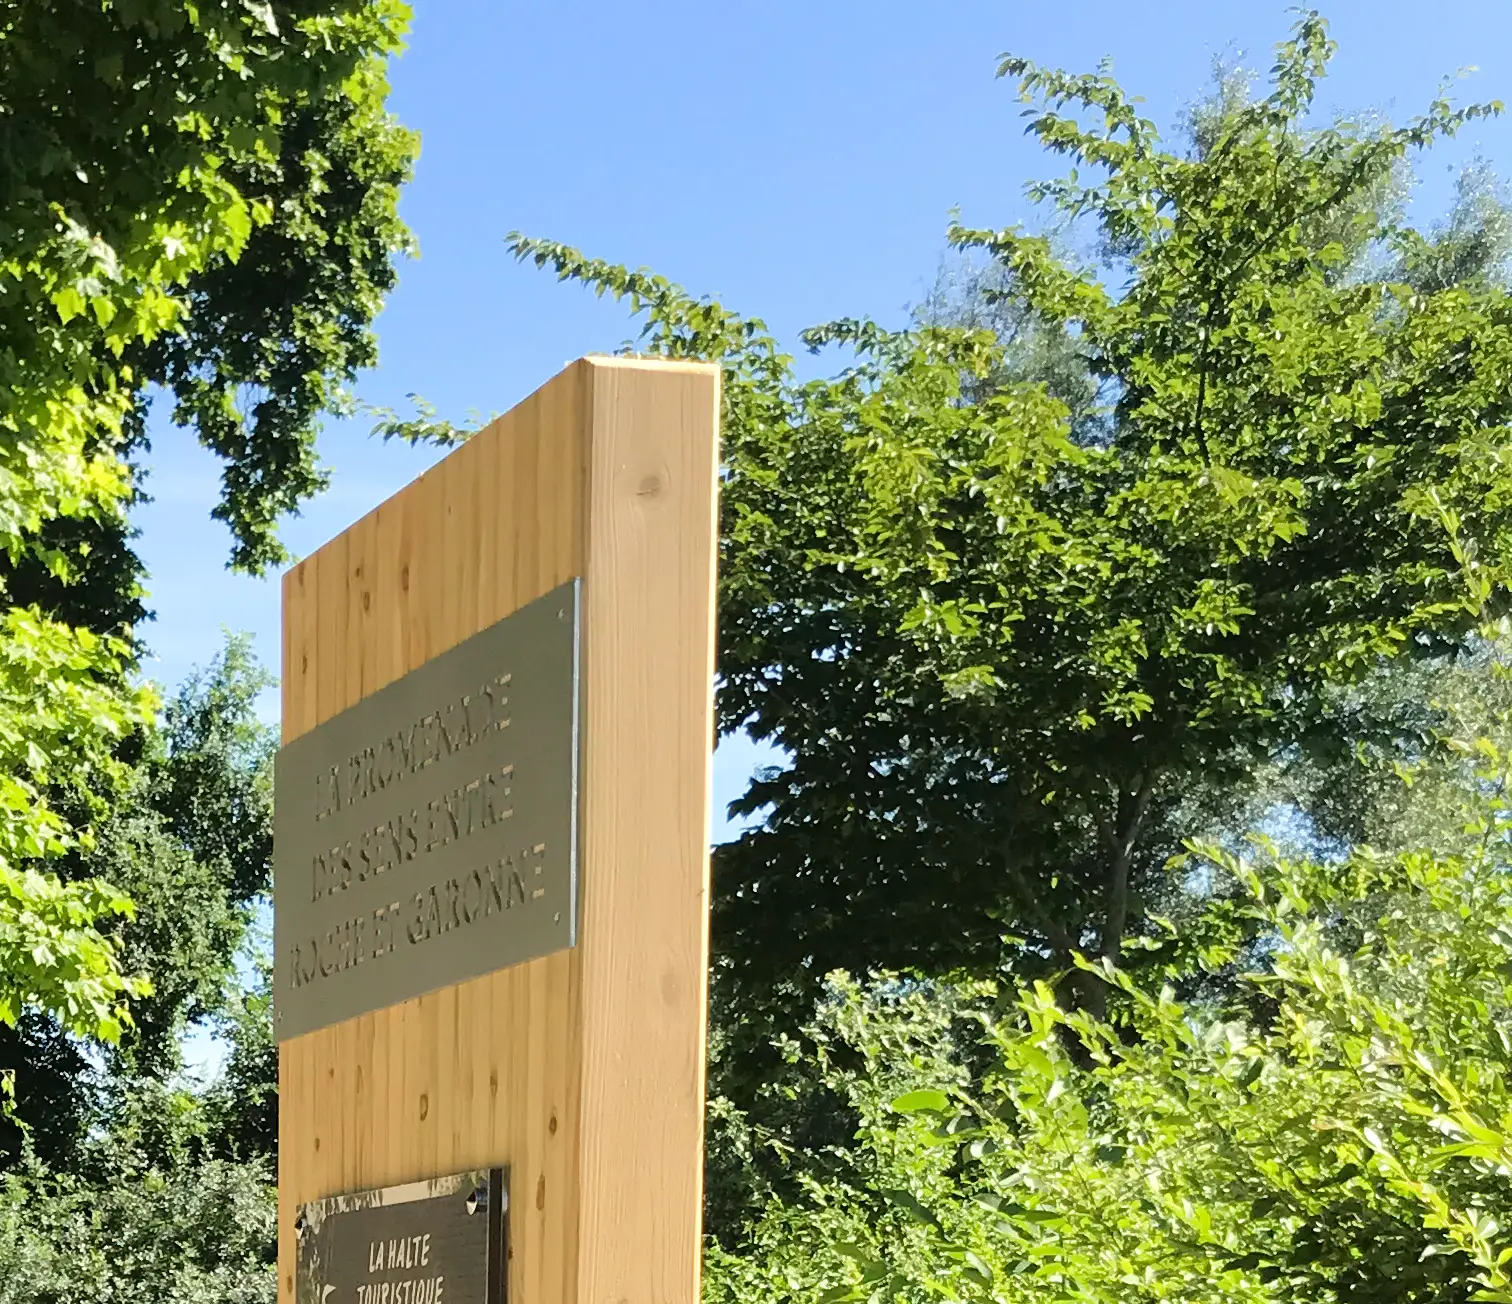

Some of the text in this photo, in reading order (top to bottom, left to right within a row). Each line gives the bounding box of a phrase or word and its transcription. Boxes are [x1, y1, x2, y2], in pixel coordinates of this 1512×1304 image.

[315, 673, 512, 822] LA PROMENADE
[311, 763, 514, 903] DES SENS ENTRE
[289, 842, 546, 991] ROCHE ET GARONNE
[368, 1233, 432, 1274] LA HALTE
